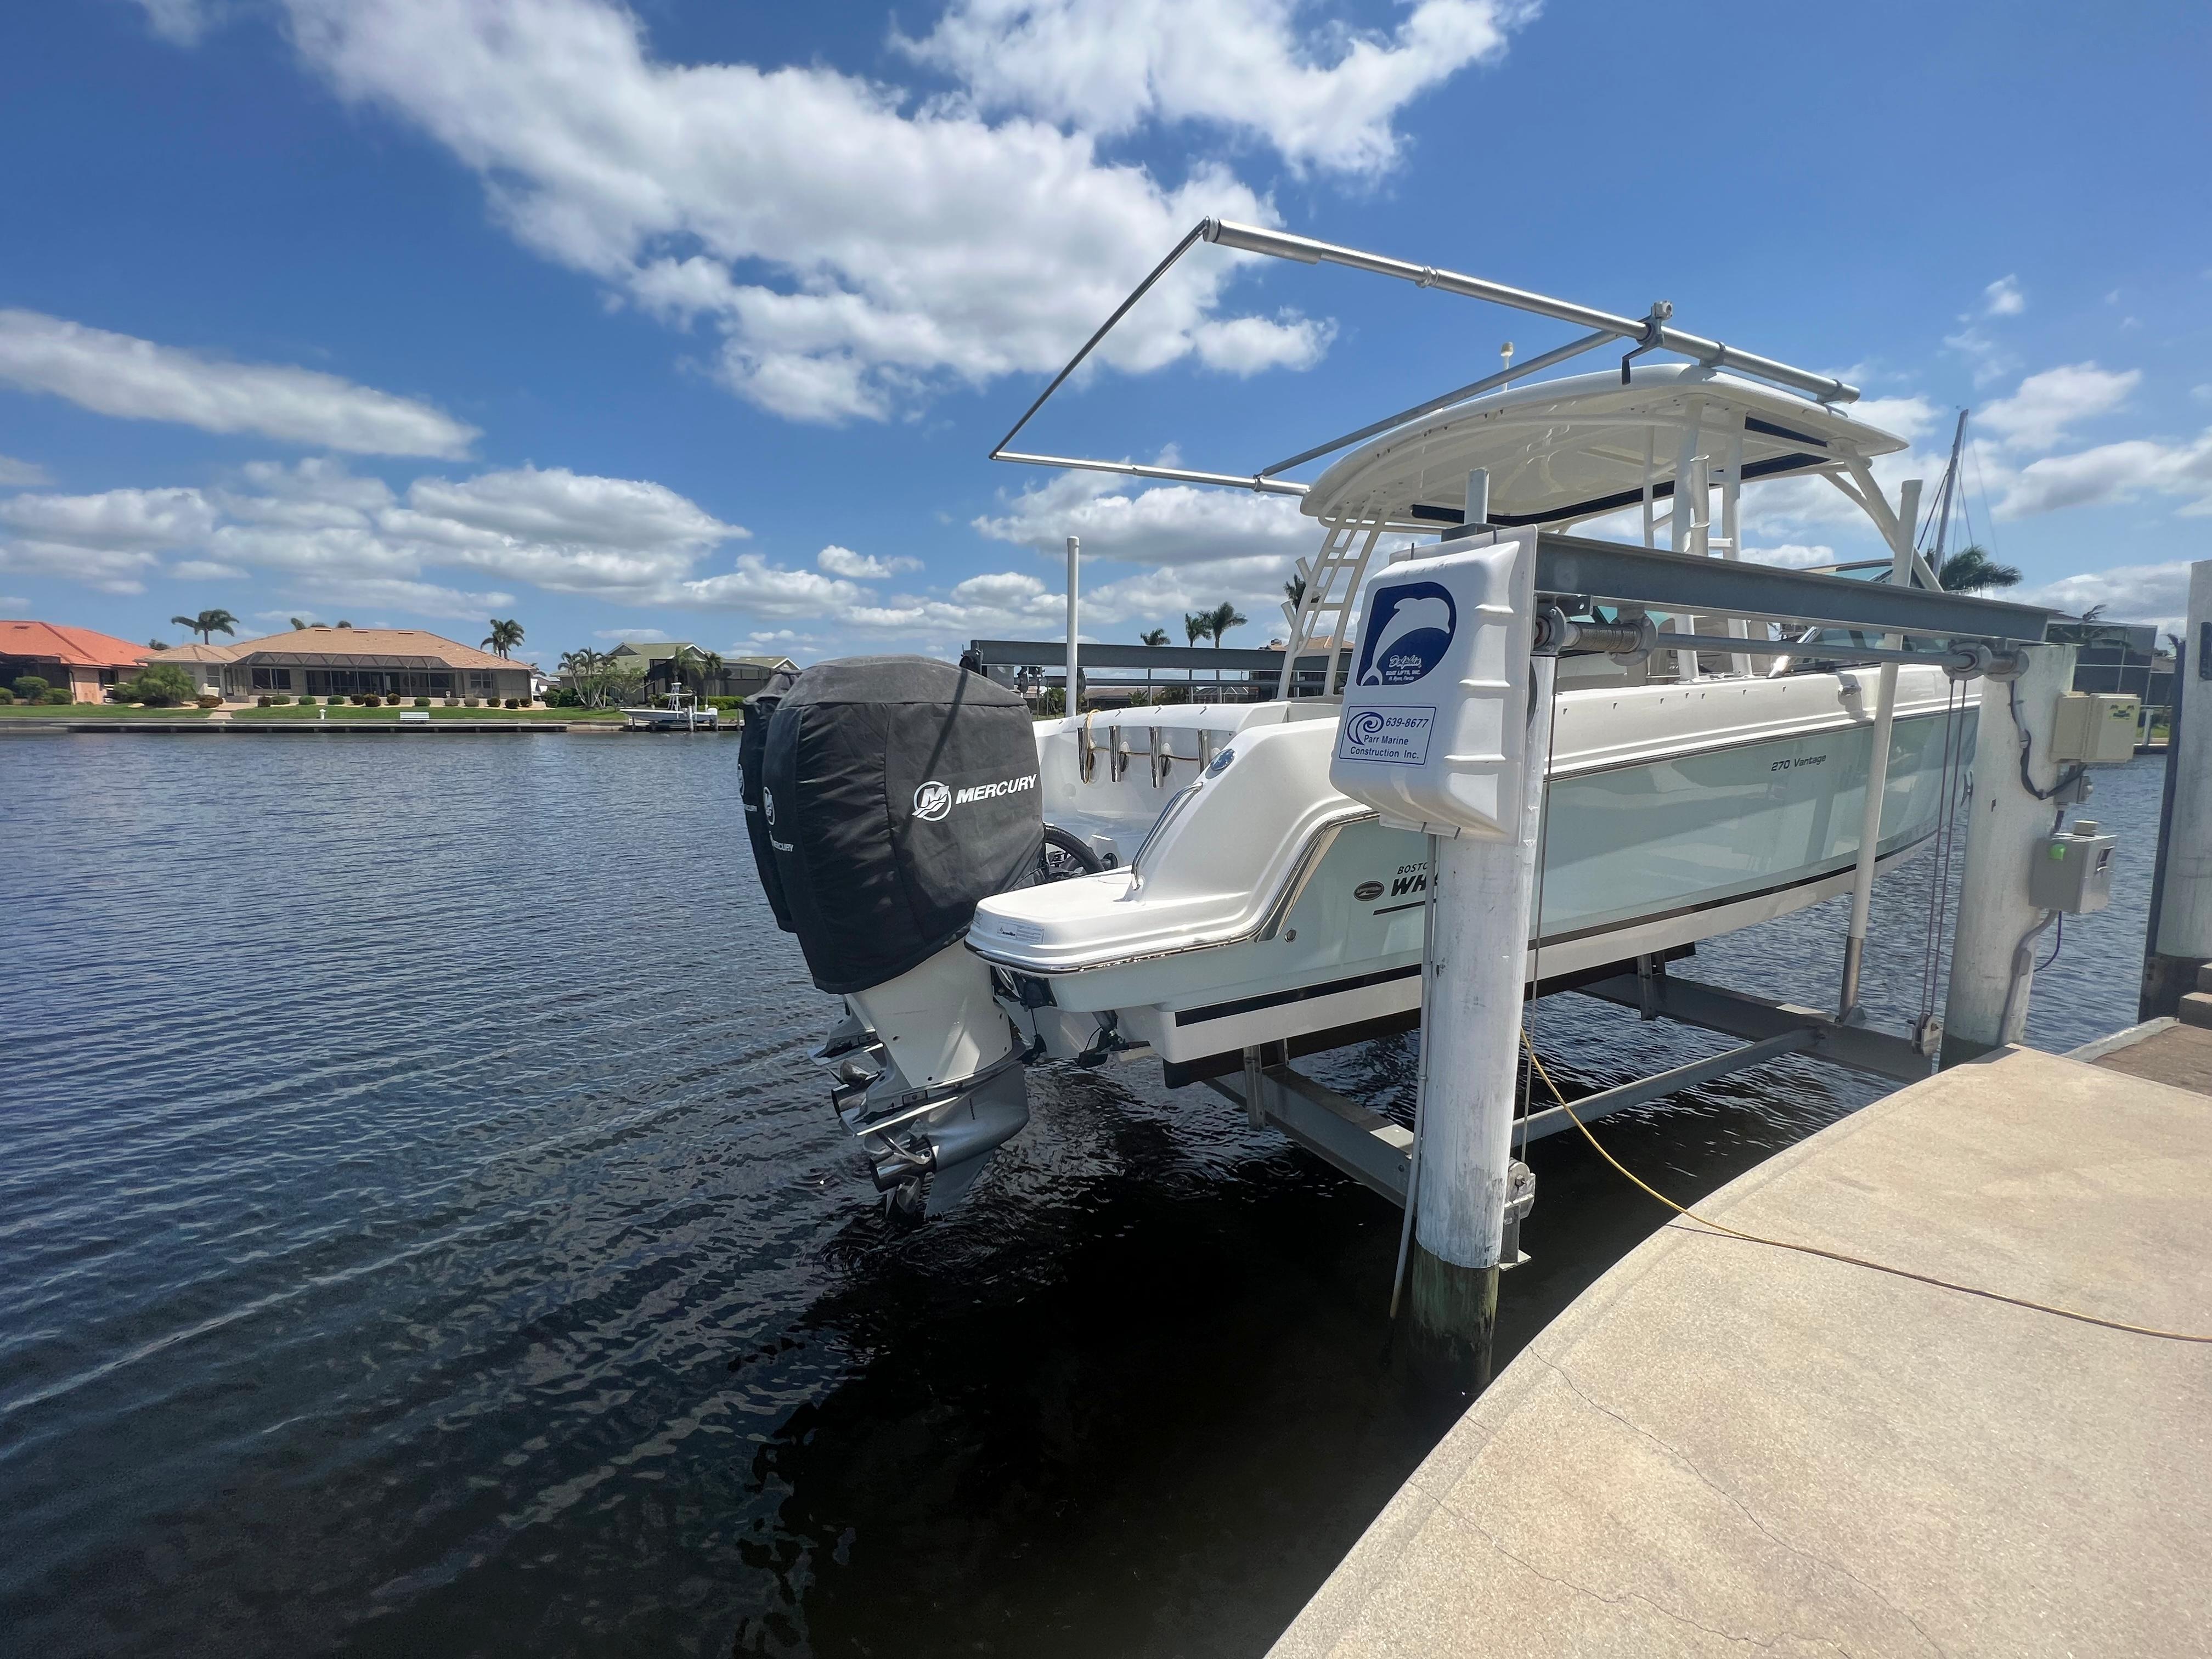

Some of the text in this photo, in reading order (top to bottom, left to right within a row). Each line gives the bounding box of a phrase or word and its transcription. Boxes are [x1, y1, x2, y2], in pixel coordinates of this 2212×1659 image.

[1389, 654, 1422, 669] Dolphin
[1385, 717, 1429, 728] 639-8677
[1364, 735, 1409, 745] Parr Marine
[1350, 746, 1419, 759] Construction Inc.
[1771, 755, 1826, 771] 270 Vantage
[956, 774, 1037, 804] MERCURY
[1397, 862, 1428, 874] BOSTO
